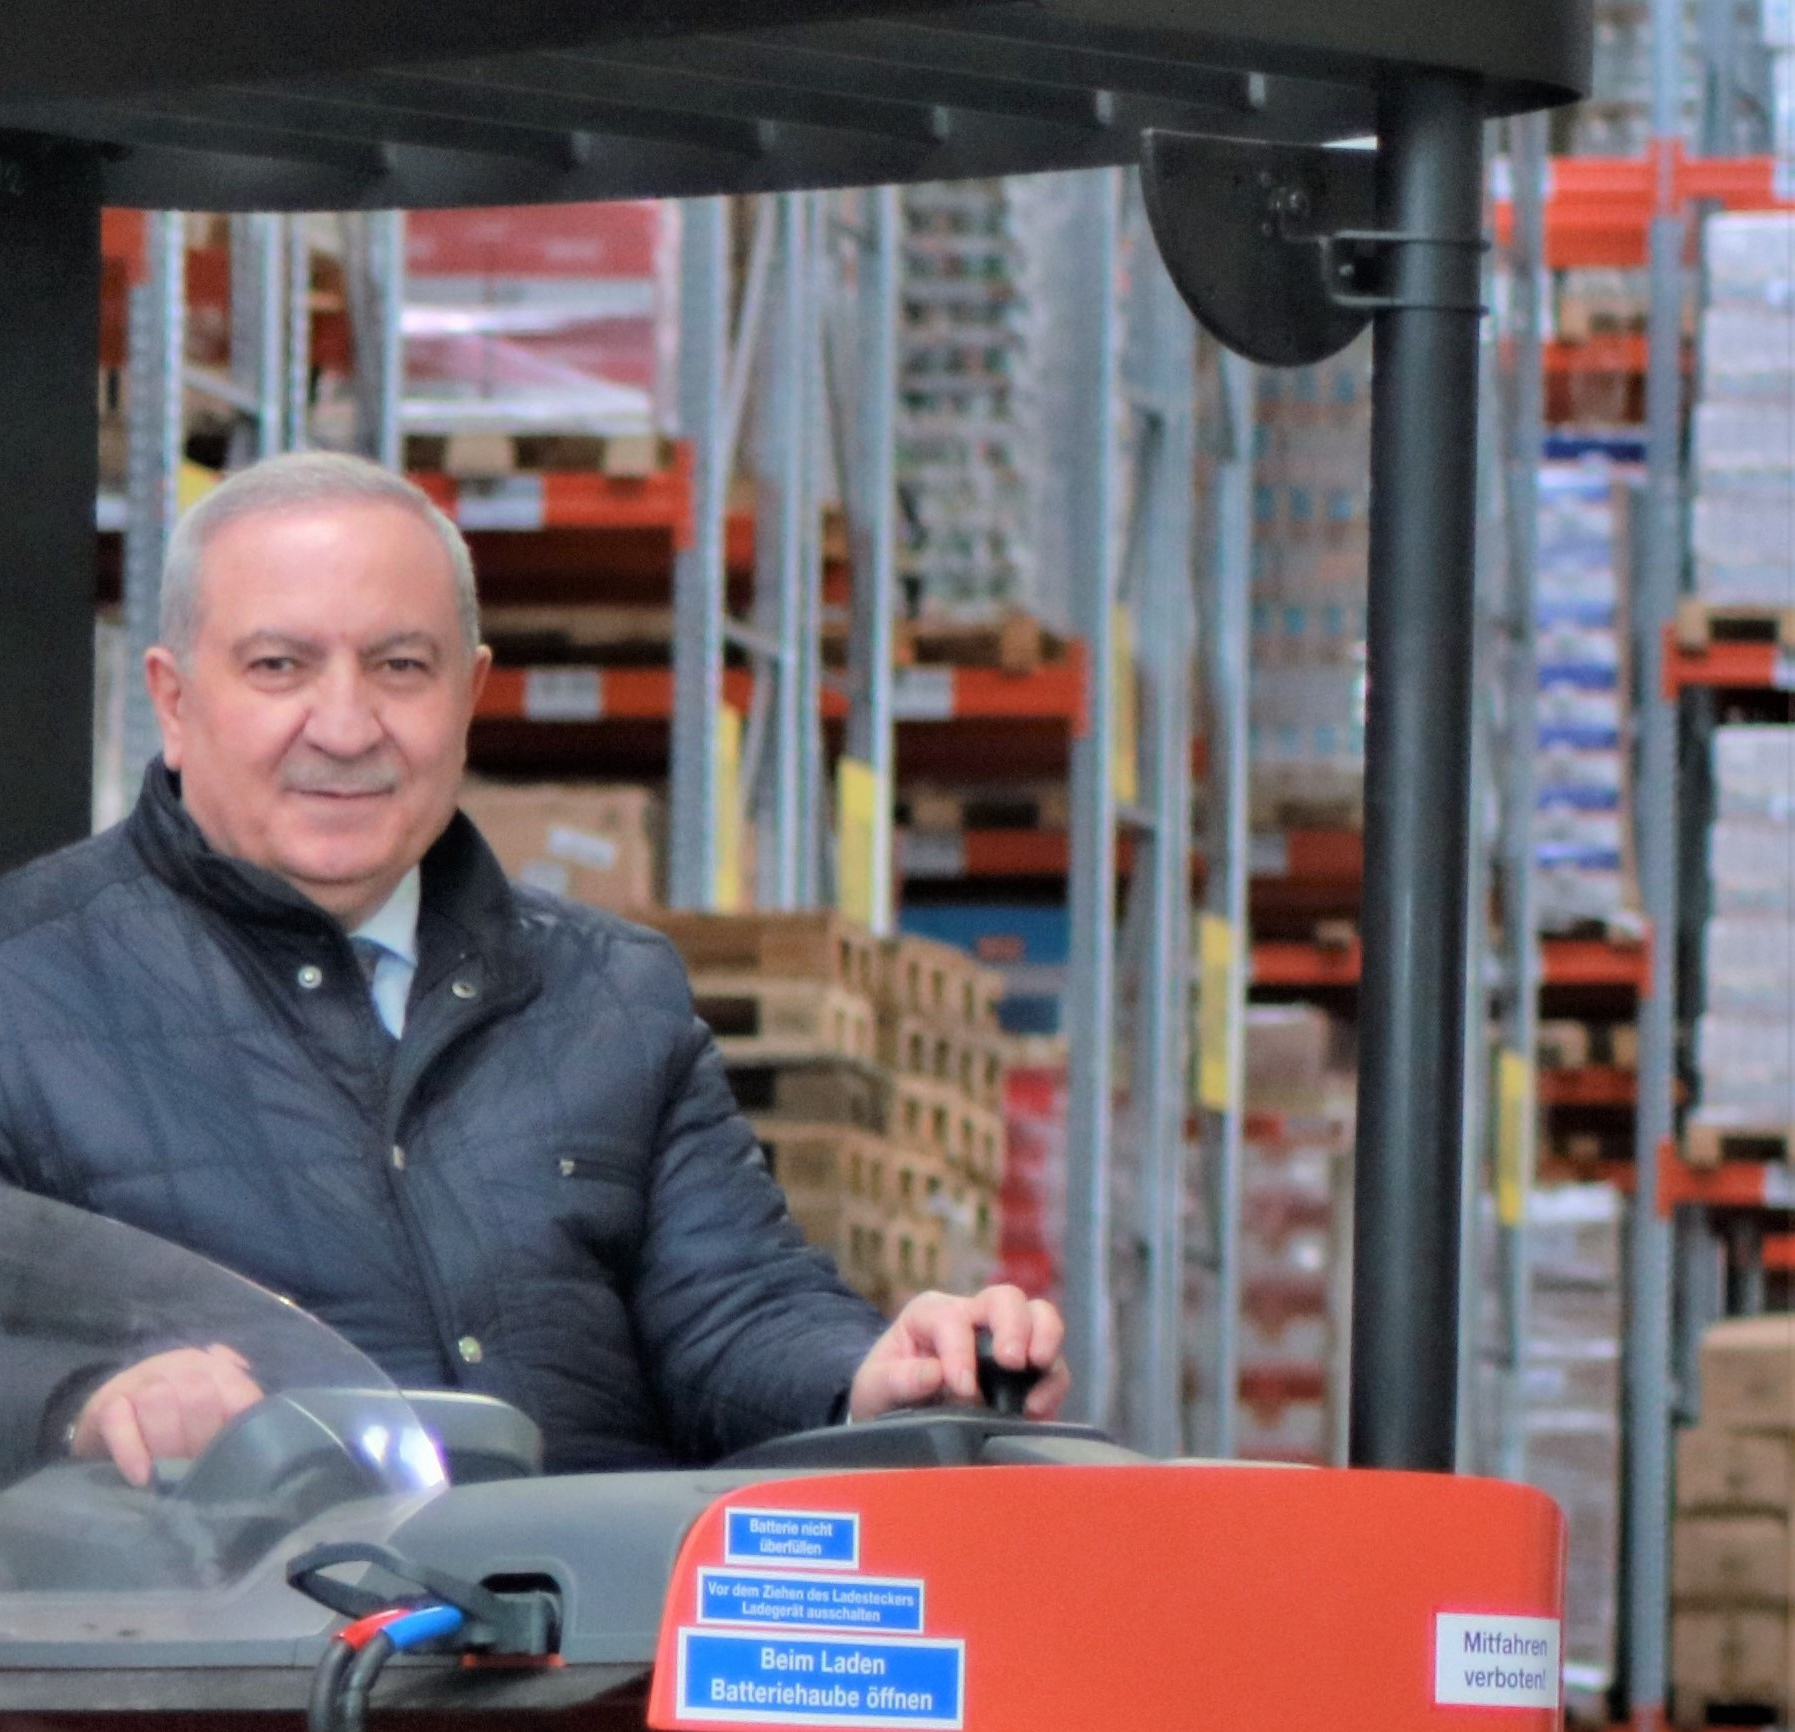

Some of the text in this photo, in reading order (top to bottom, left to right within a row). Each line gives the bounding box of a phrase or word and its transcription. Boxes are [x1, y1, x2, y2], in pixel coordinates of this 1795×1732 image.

[749, 1517, 834, 1536] Batterie nicht
[759, 1537, 823, 1555] überfüllen
[708, 1581, 915, 1606] Vor dem Ziehen des Ladesteckers
[741, 1601, 881, 1622] Ladegerät ausschalten
[1463, 1630, 1549, 1657] Mitfahren
[760, 1647, 886, 1676] Beim Laden
[1463, 1665, 1547, 1691] verboten!
[710, 1678, 934, 1711] Batteriehaube öffnen
